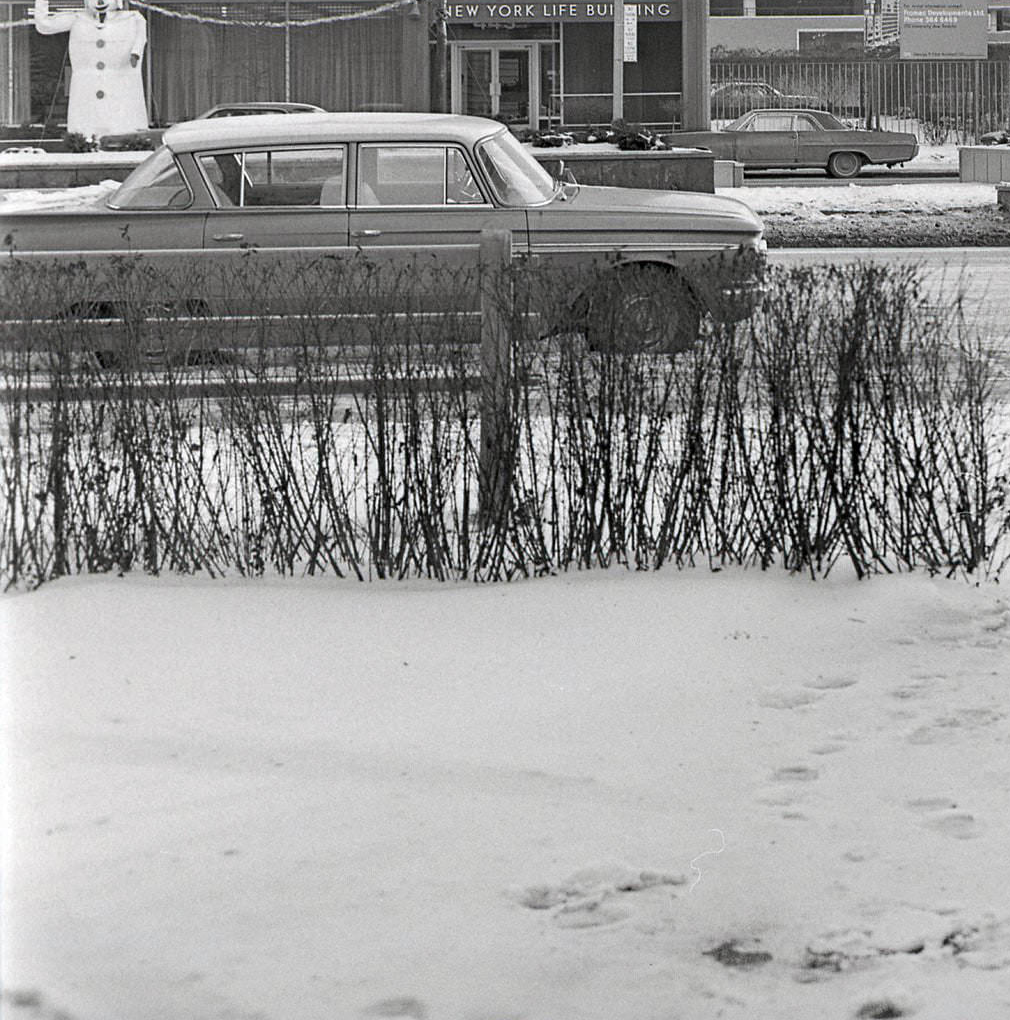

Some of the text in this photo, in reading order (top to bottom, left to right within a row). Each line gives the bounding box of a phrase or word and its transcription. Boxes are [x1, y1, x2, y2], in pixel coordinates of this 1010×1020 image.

[487, 4, 535, 17] YORK
[543, 4, 577, 17] LIFE
[587, 4, 670, 17] BUIING
